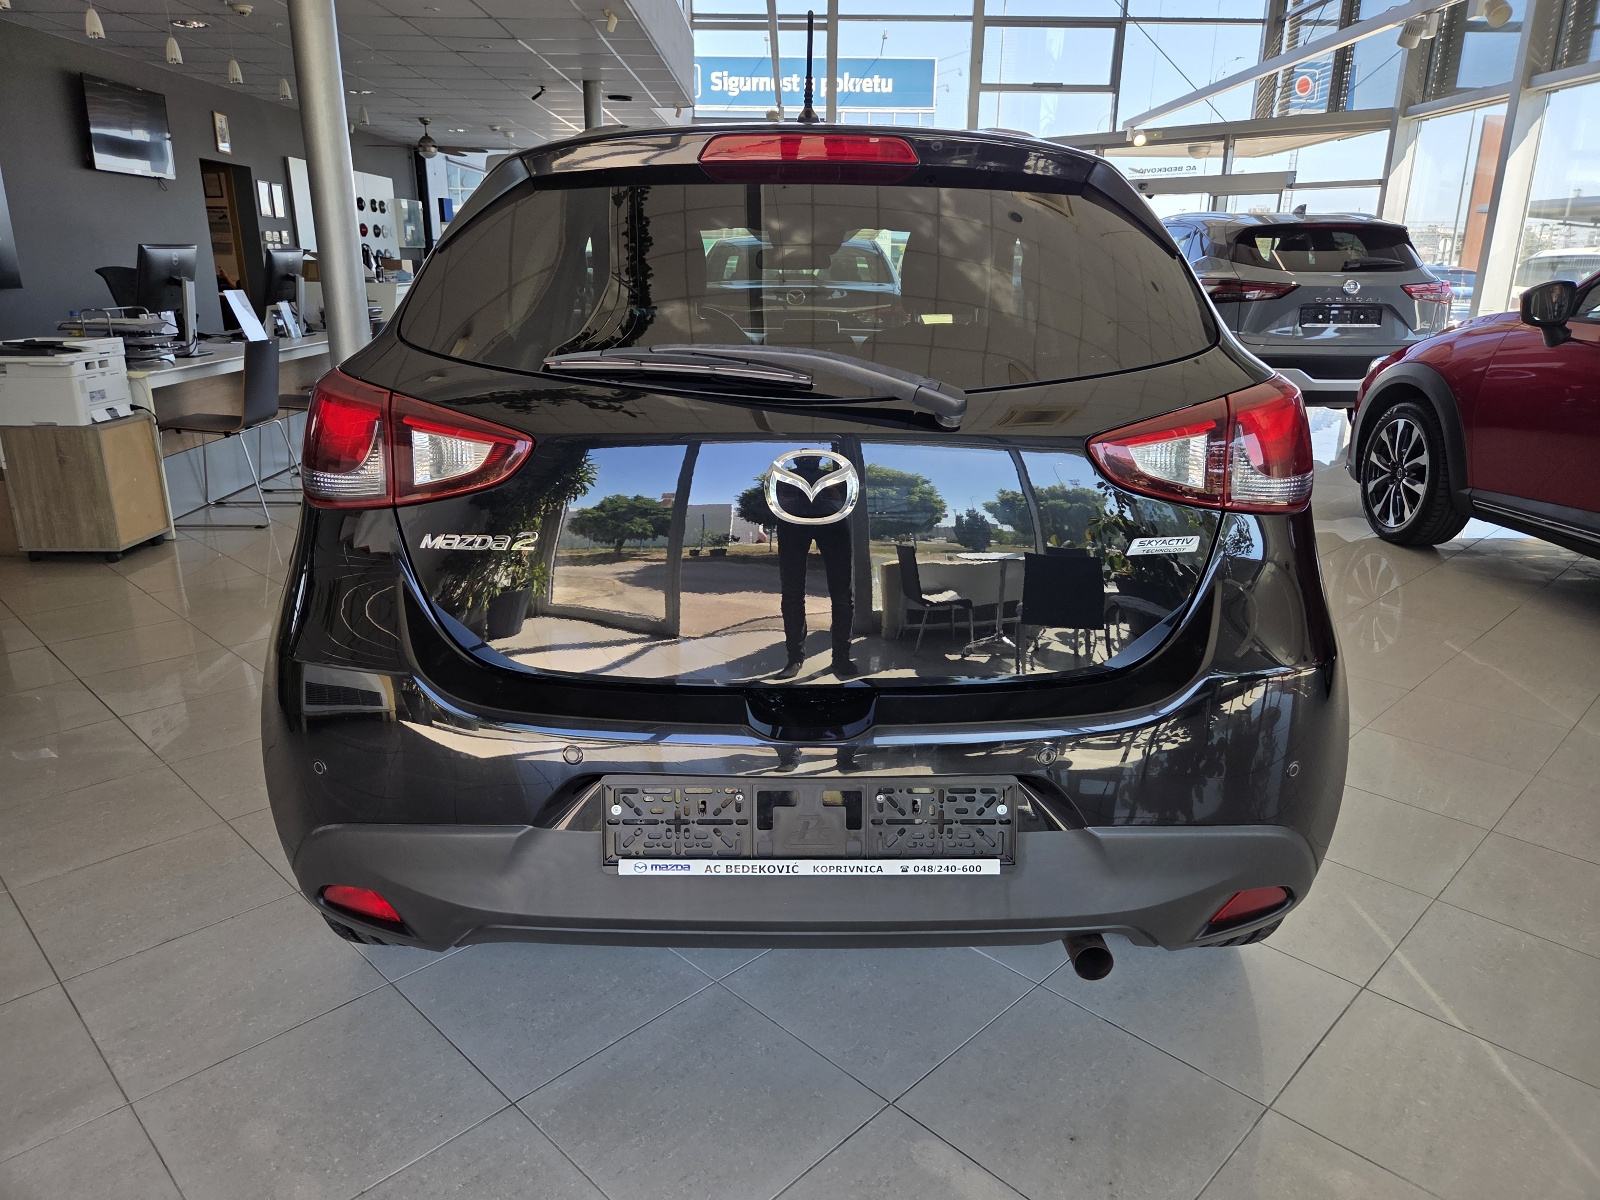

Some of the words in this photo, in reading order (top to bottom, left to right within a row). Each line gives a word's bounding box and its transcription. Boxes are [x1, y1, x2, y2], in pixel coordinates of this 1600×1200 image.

[1137, 537, 1194, 547] SKYACTIV
[704, 864, 722, 874] AC
[725, 862, 800, 874] BEDEKOVIĆ
[812, 864, 884, 873] KOPRIVNICA
[912, 864, 982, 873] 048/240-600
